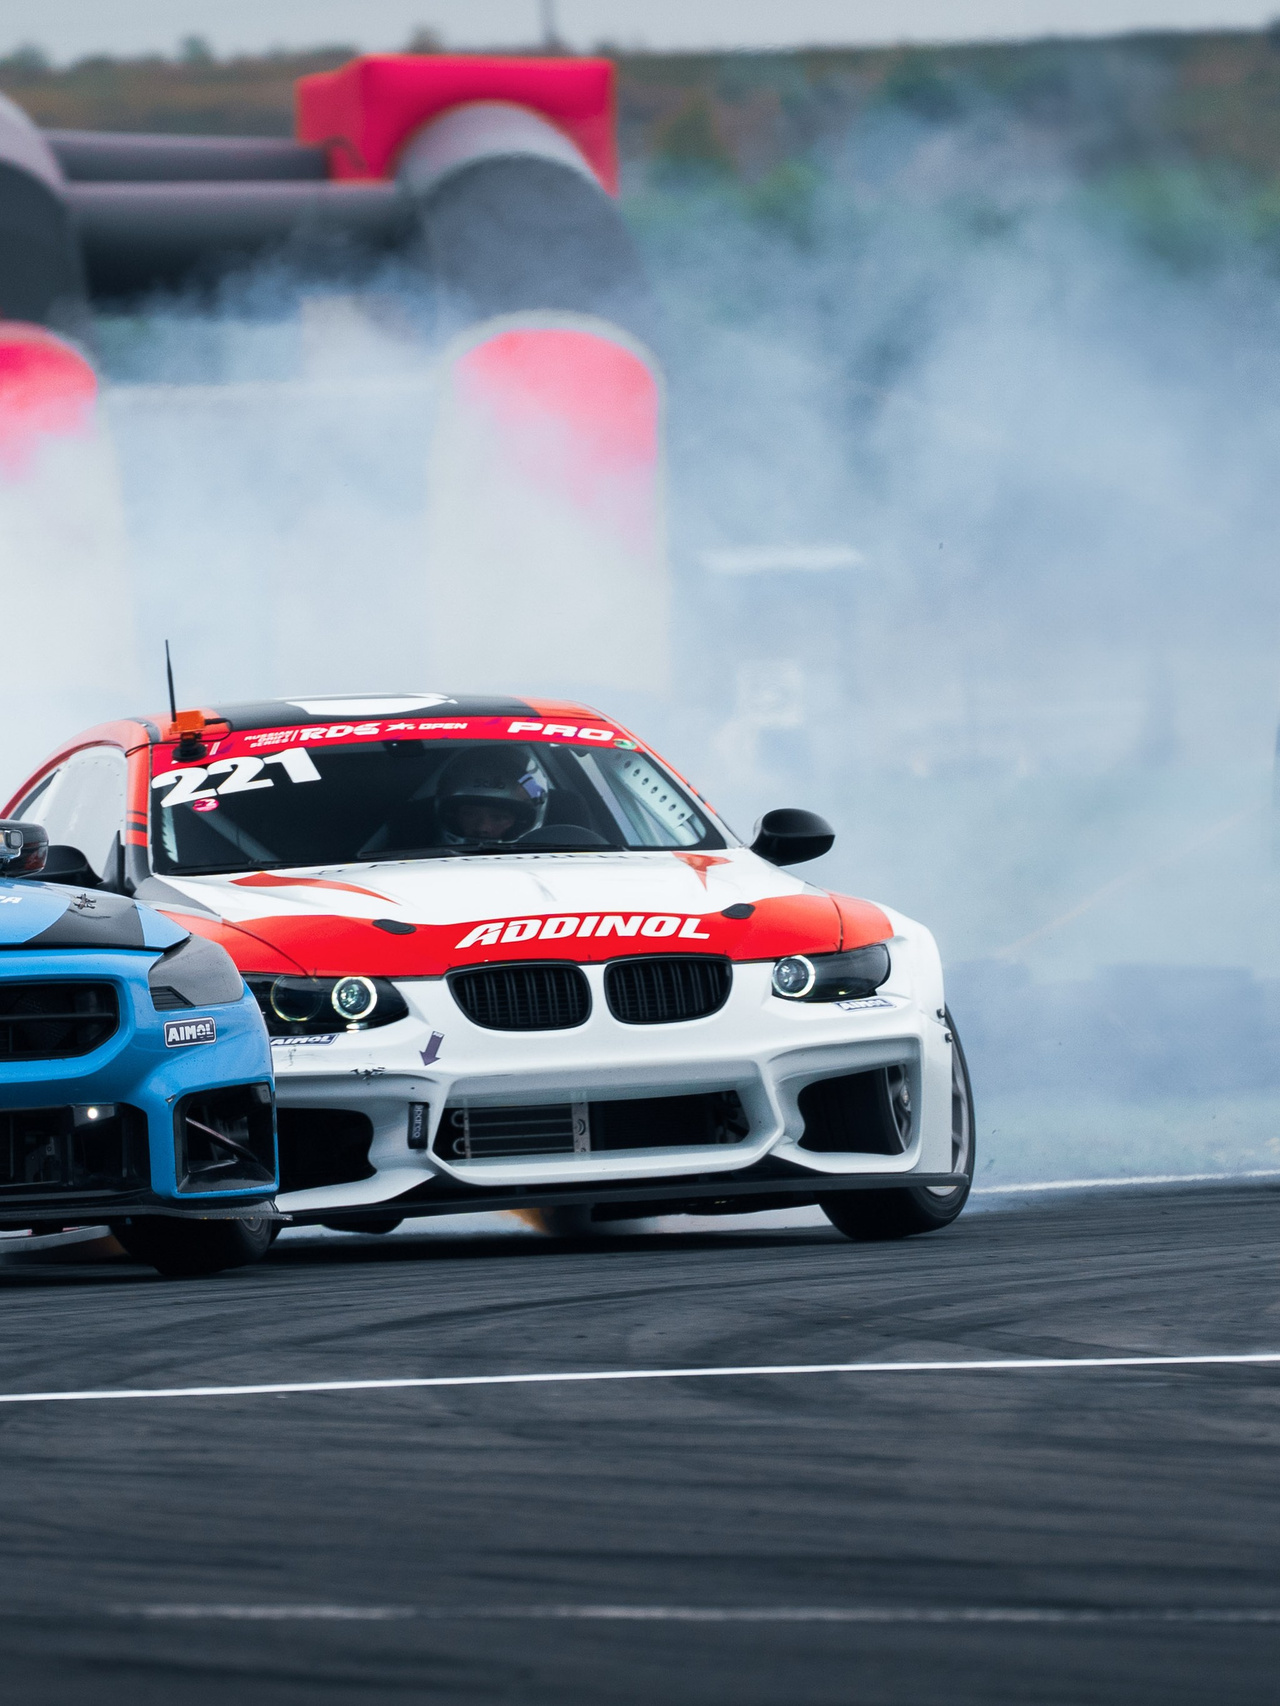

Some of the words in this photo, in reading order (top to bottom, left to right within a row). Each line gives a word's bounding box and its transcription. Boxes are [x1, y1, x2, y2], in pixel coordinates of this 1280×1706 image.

[507, 721, 615, 741] PRO
[151, 747, 322, 808] 221
[454, 916, 710, 949] ADDINOL
[167, 1023, 214, 1042] AIMOL
